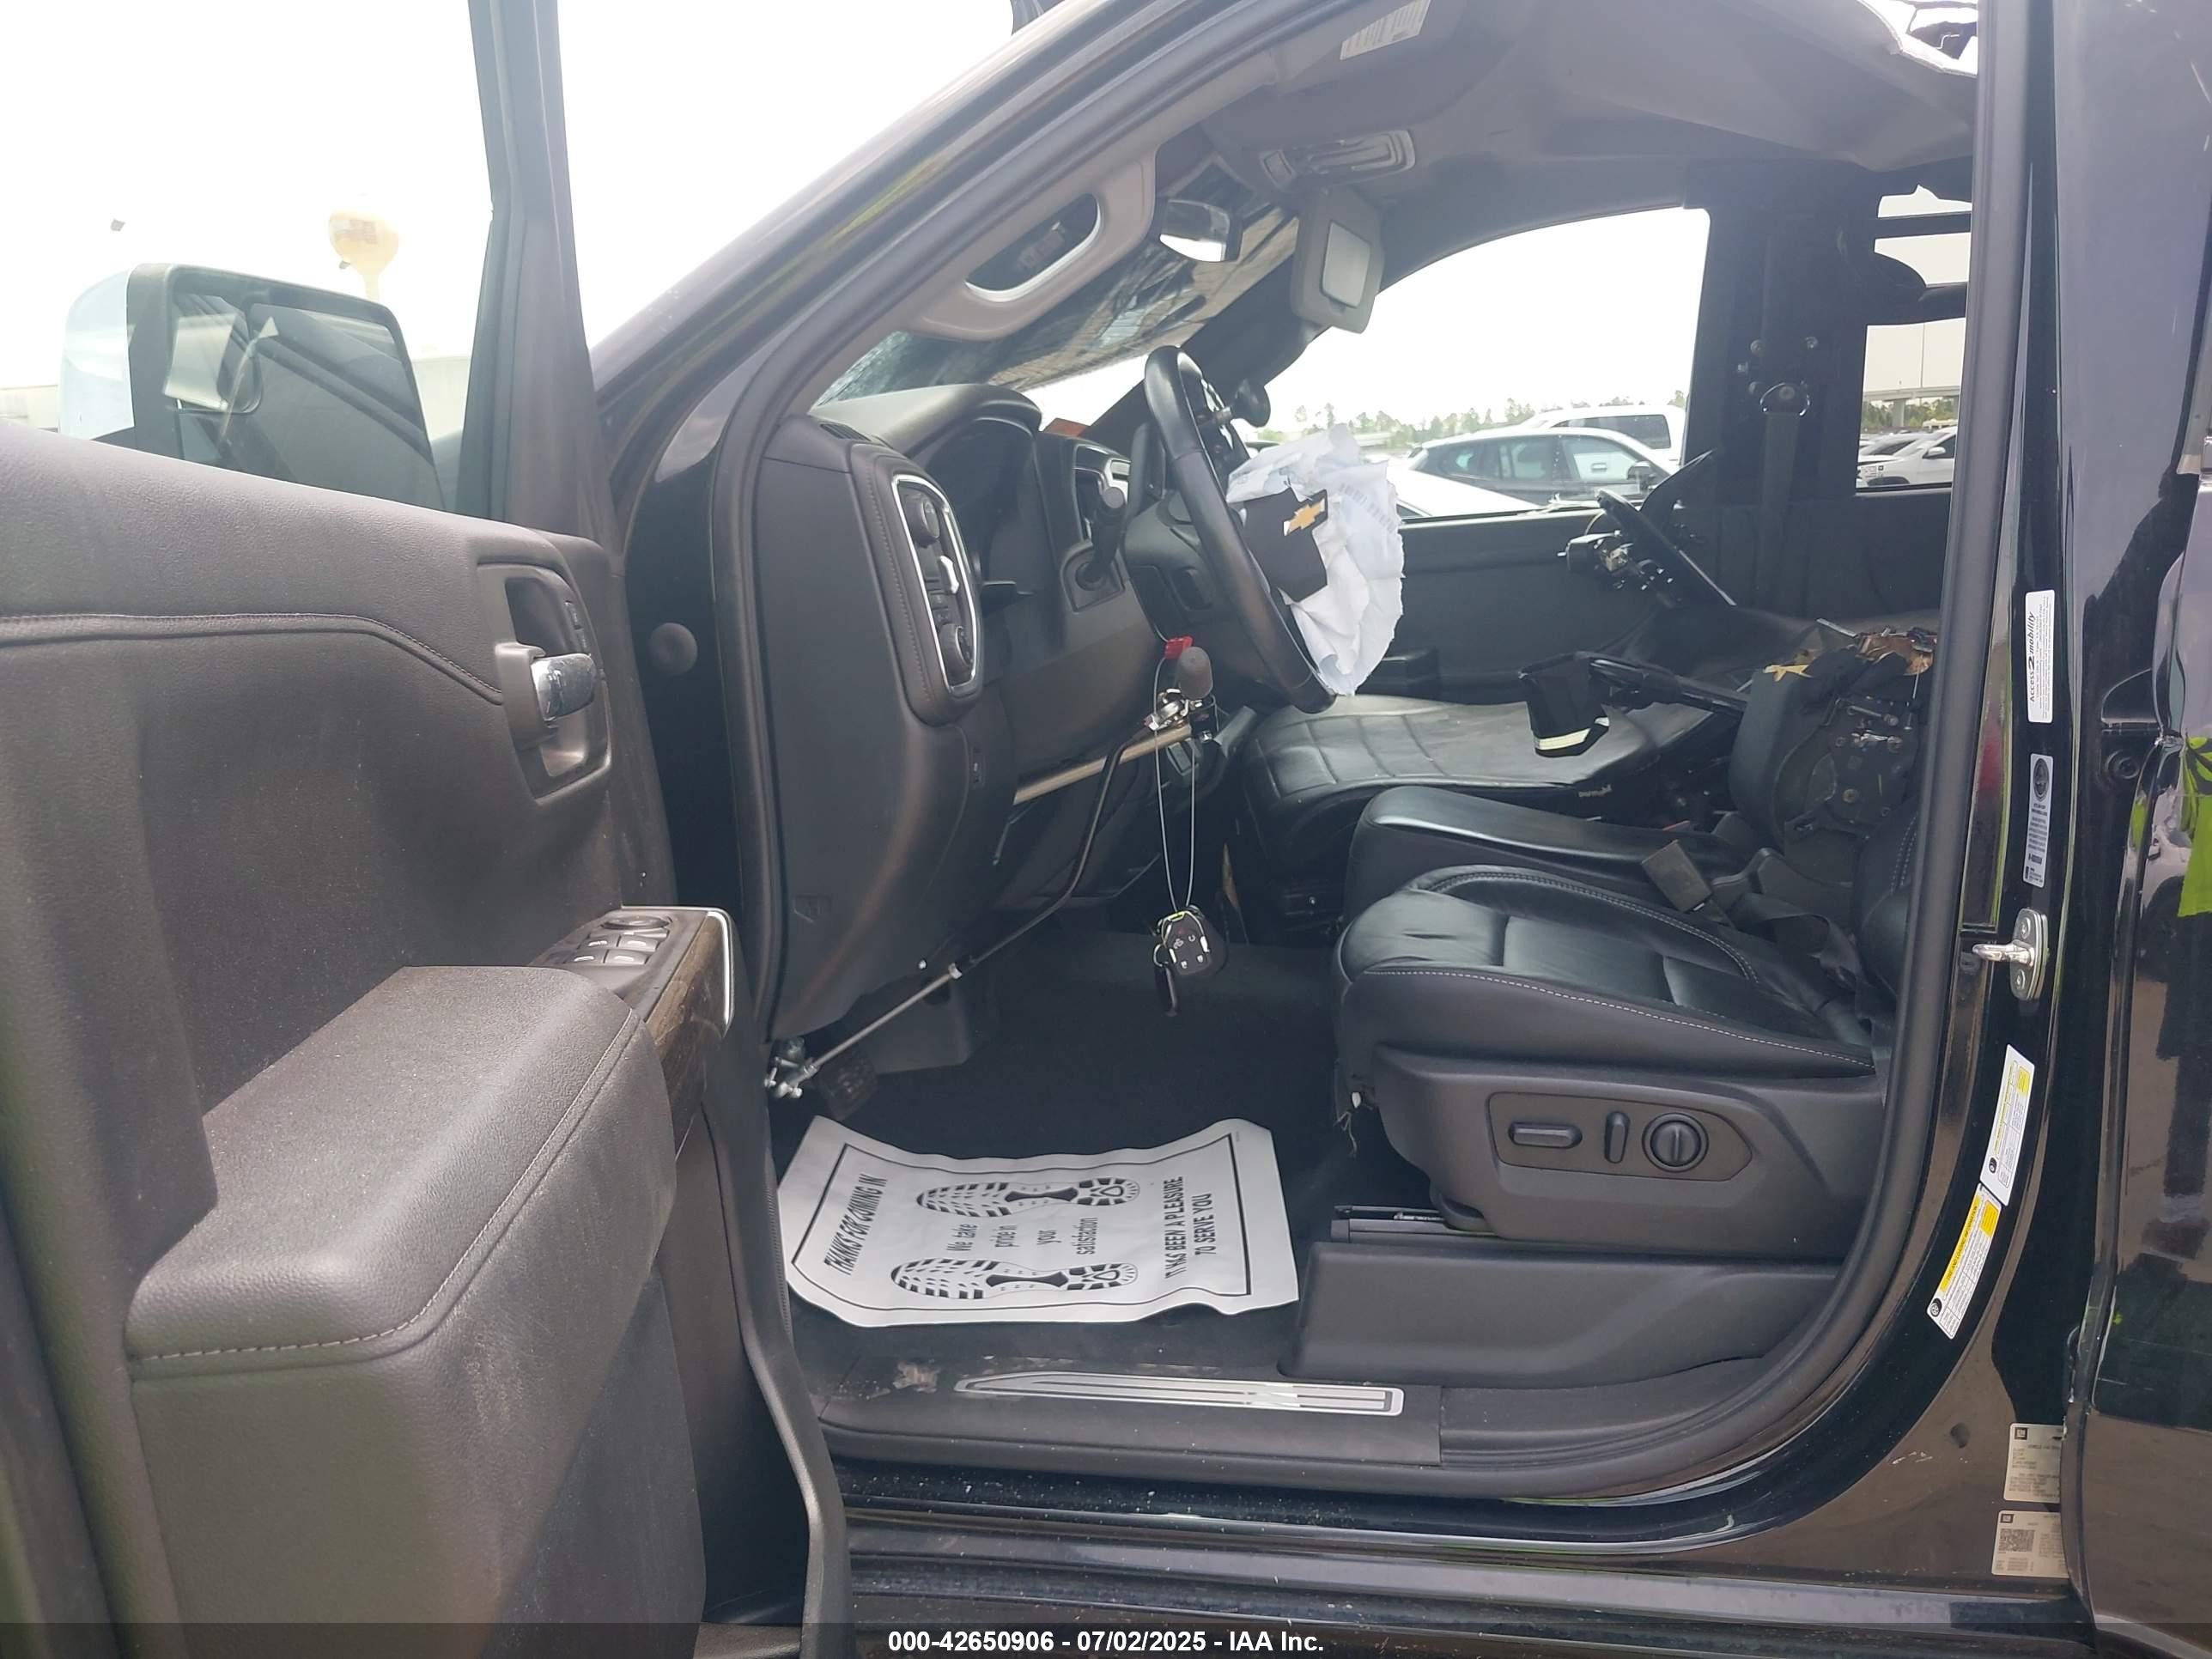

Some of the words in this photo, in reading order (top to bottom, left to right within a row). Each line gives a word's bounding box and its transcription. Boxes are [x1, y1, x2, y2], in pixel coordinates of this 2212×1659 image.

[859, 1173, 888, 1188] IN
[1163, 1176, 1185, 1220] PLEASURE
[1191, 1193, 1213, 1214] YOU
[839, 1213, 872, 1241] FOR
[951, 1223, 978, 1238] take
[1072, 1217, 1099, 1255] satisfaction
[1193, 1214, 1216, 1243] SERVE
[946, 1241, 974, 1252] We
[989, 1231, 1021, 1248] pride
[1036, 1230, 1061, 1246] your
[1164, 1230, 1186, 1250] BEEN
[823, 1231, 863, 1276] THANKS
[1194, 1245, 1217, 1255] TO
[1164, 1266, 1187, 1279] IT
